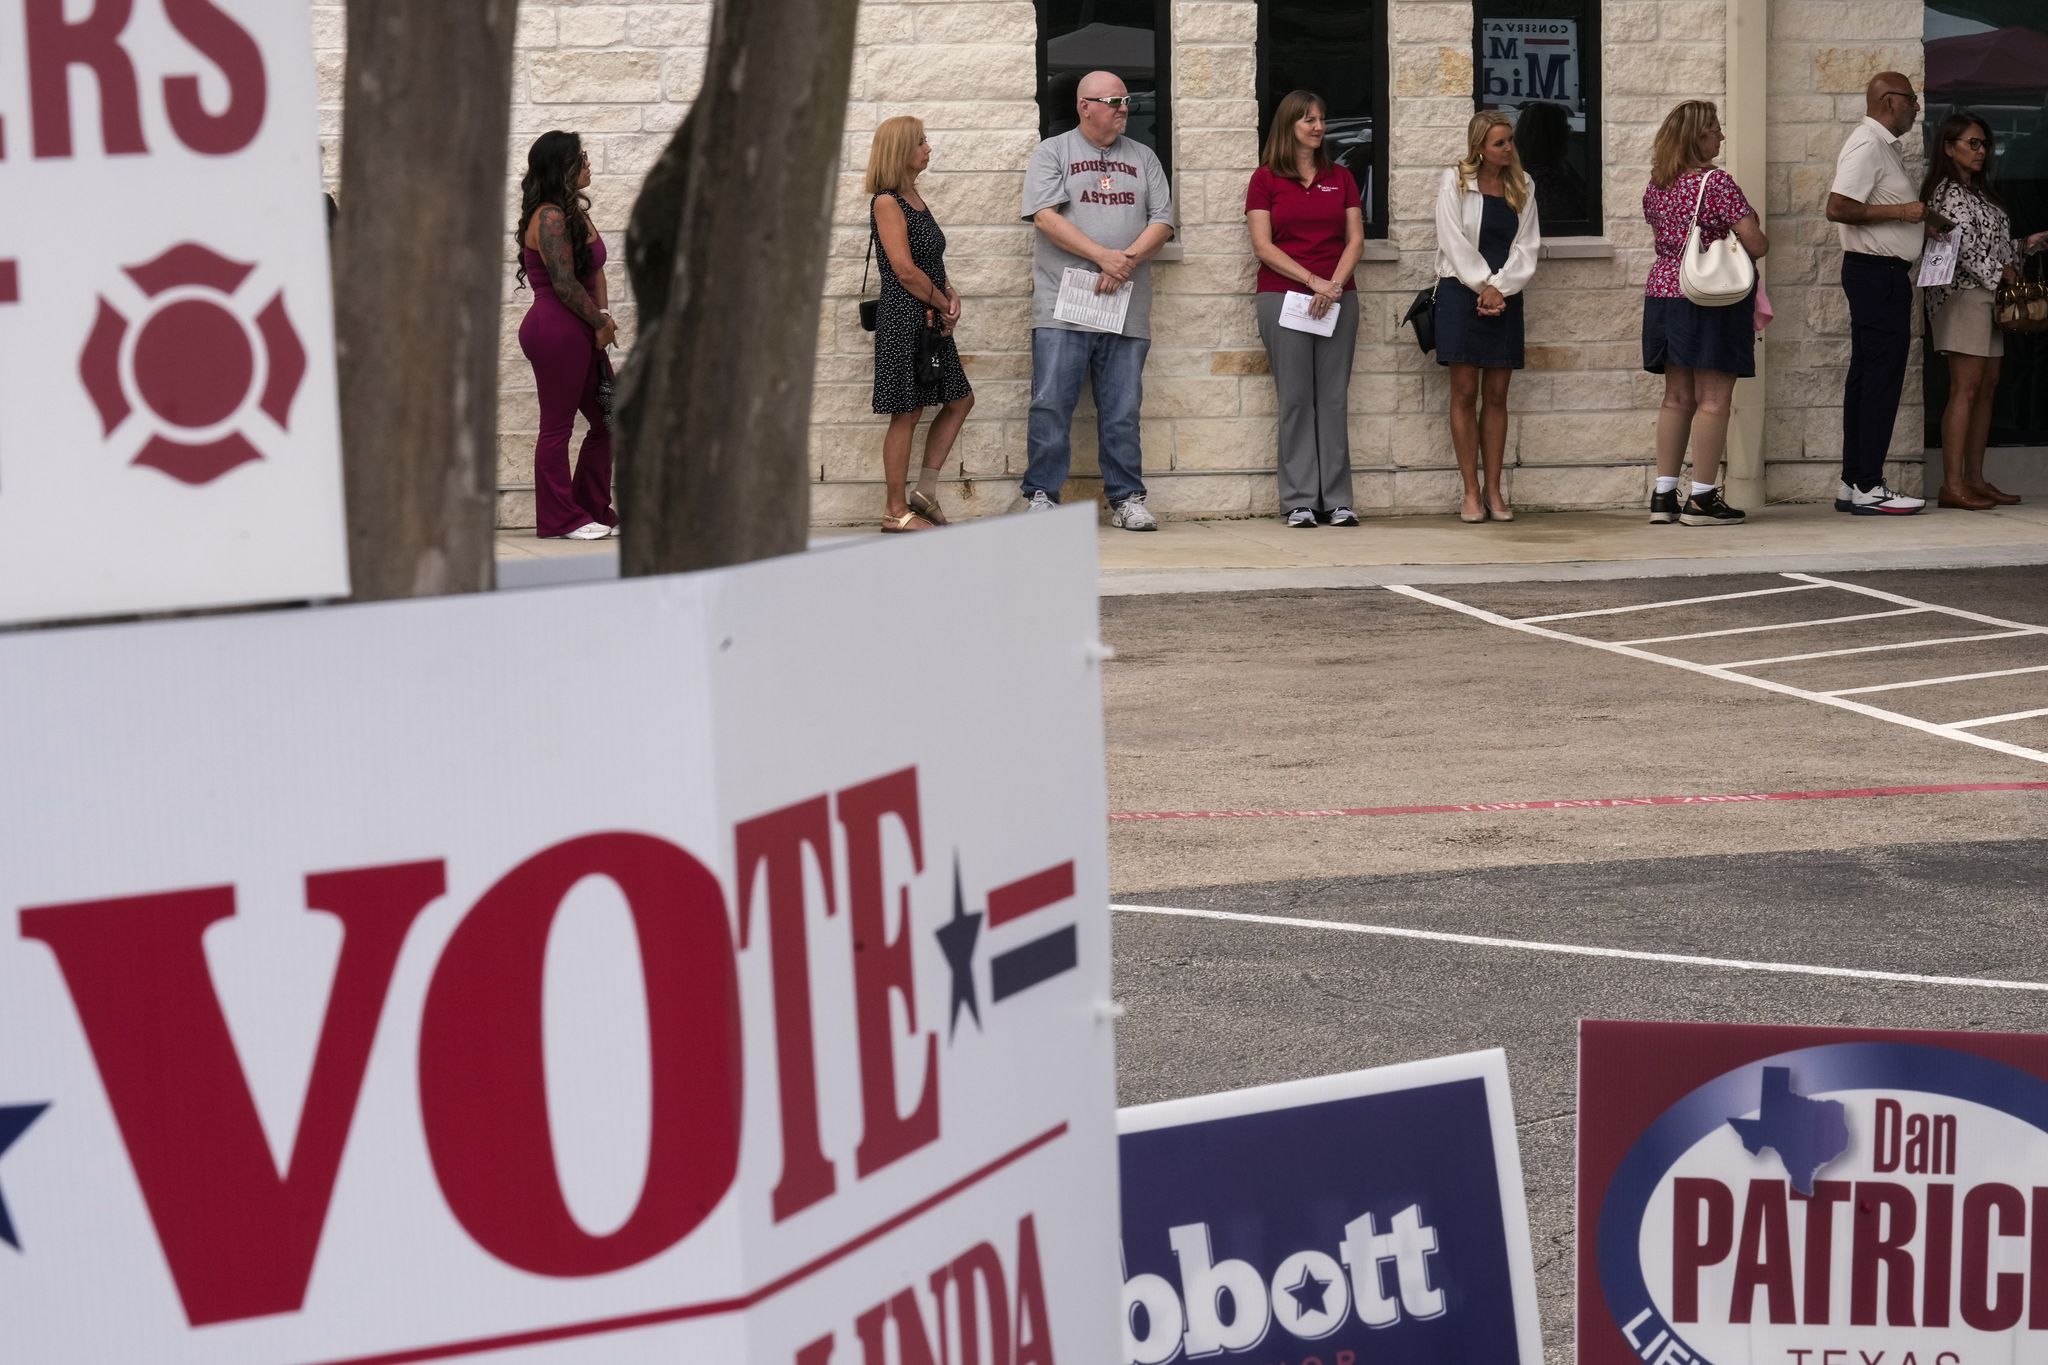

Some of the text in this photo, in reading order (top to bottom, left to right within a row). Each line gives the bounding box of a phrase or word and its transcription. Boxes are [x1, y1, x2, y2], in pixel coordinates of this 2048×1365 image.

[0, 0, 268, 160] RS
[1071, 160, 1138, 178] HOUSTON
[1080, 190, 1136, 206] ASTROS
[1452, 802, 1528, 812] TOW
[1553, 798, 1654, 807] AWAY
[18, 765, 941, 1327] VOTE
[1873, 1098, 1957, 1175] Dan
